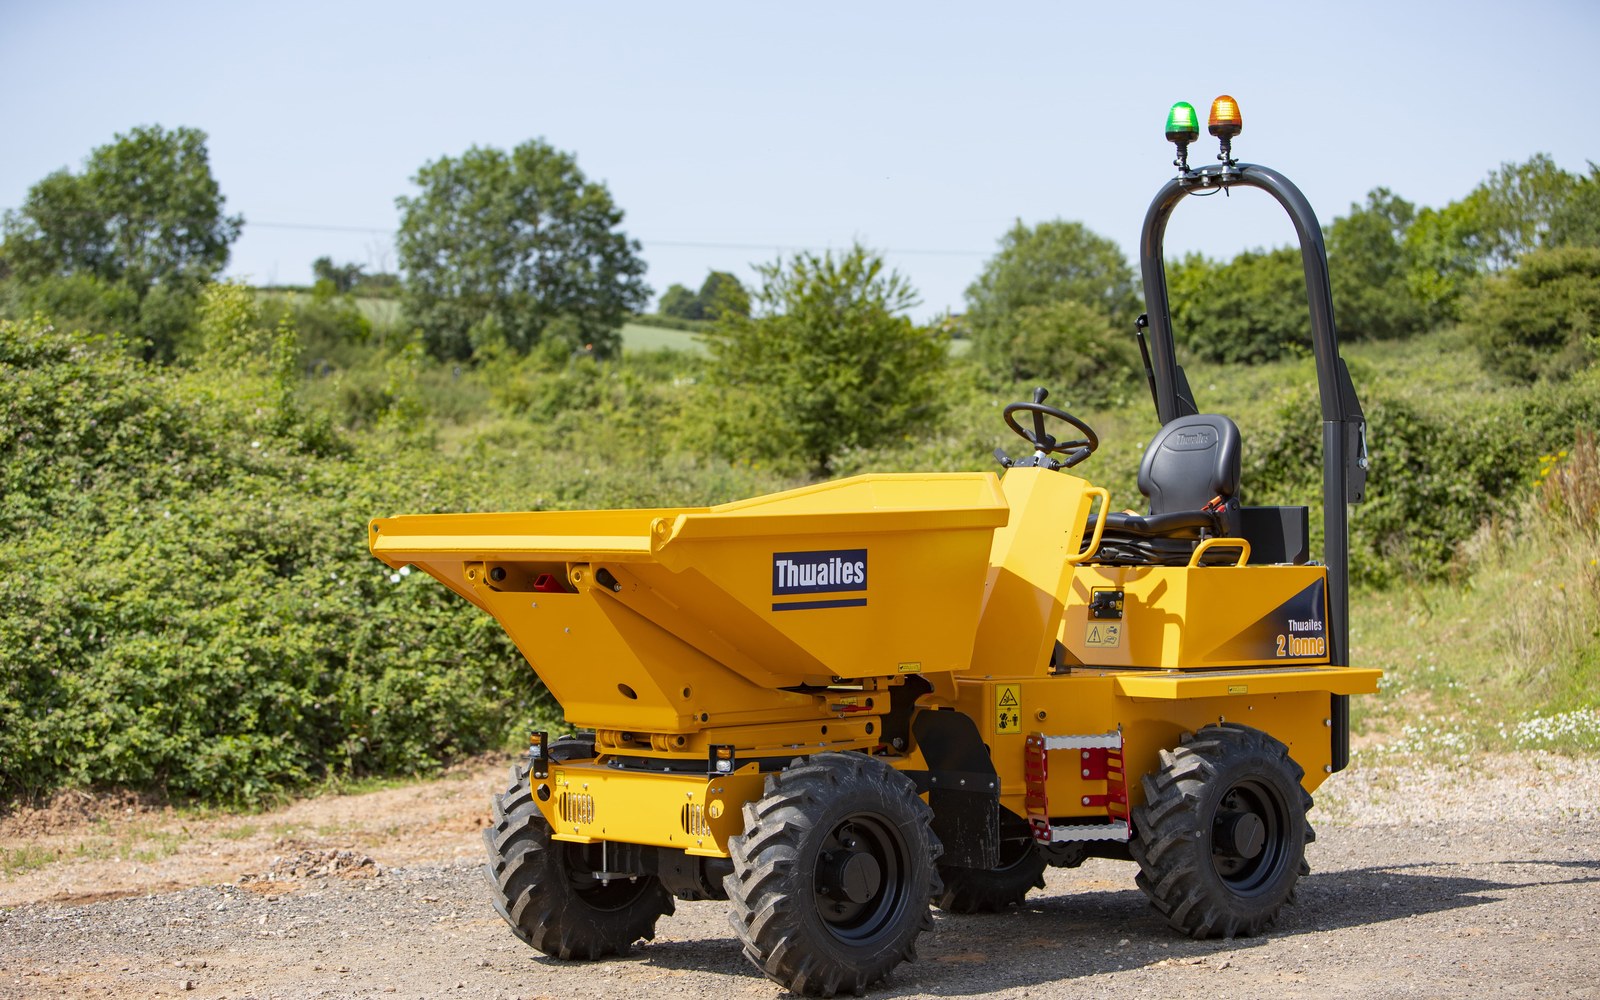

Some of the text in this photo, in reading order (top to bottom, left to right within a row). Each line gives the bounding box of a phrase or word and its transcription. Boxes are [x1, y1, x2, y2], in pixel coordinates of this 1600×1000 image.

[776, 557, 865, 588] Thwaites
[1288, 619, 1323, 632] Thwaites
[1276, 634, 1325, 657] 2 tonne
